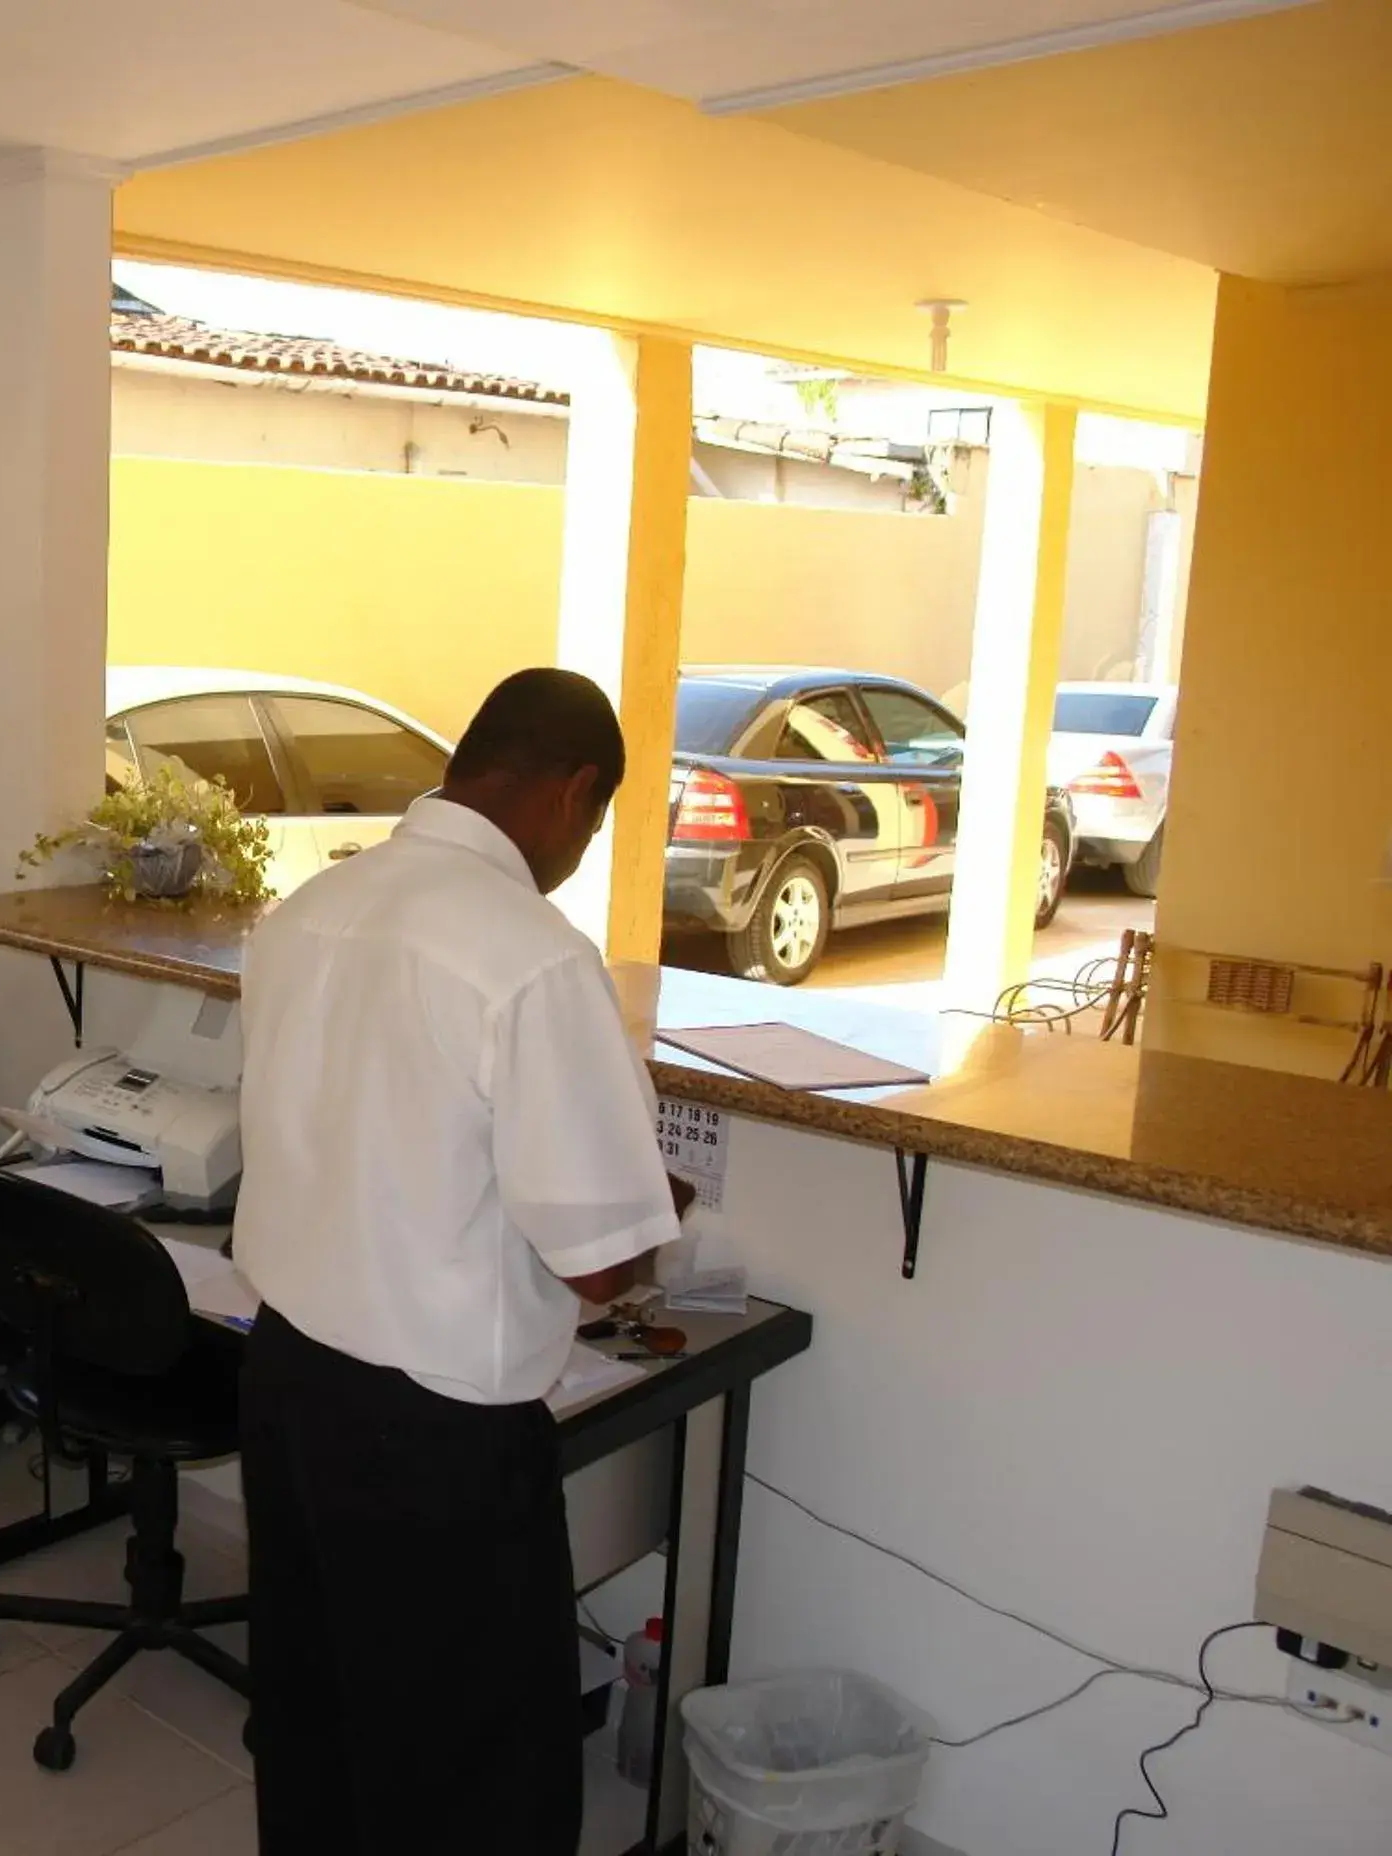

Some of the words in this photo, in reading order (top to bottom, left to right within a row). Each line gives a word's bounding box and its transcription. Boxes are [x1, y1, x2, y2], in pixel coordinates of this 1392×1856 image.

[670, 1104, 683, 1118] 17
[688, 1107, 701, 1122] 18
[706, 1111, 719, 1126] 19
[668, 1122, 681, 1137] 24
[686, 1126, 700, 1142] 25
[703, 1130, 718, 1146] 26
[666, 1142, 679, 1156] 31
